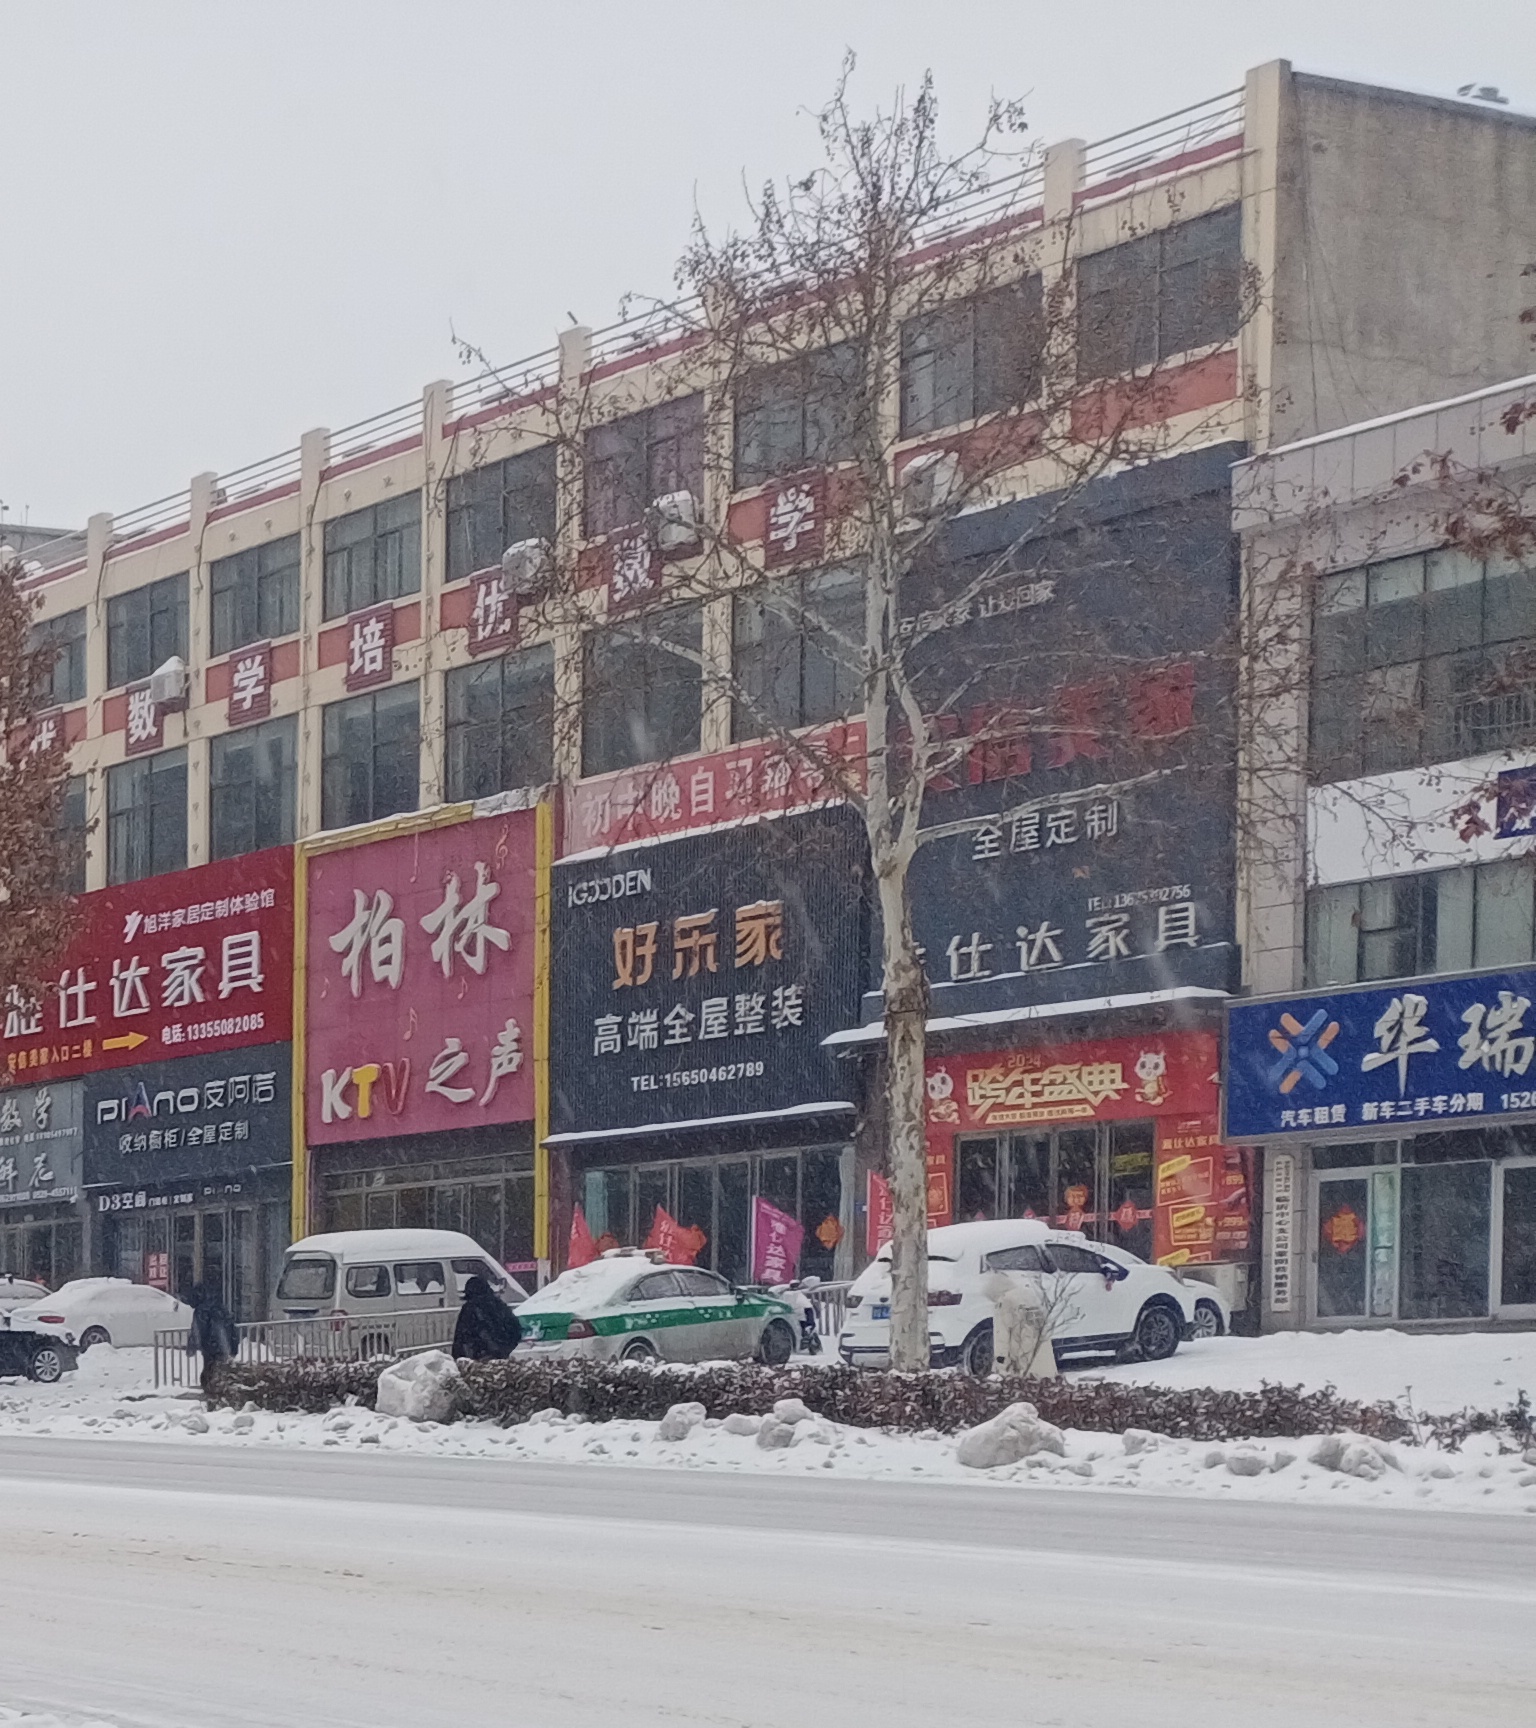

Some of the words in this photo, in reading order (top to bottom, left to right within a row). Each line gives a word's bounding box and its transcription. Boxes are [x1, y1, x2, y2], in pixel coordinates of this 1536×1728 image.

[972, 799, 1119, 861] 全屋定制
[329, 862, 514, 999] 柏林
[612, 899, 785, 991] 好乐家
[915, 901, 1201, 982] 仕达家具
[593, 983, 805, 1057] 高端全屋整装
[1360, 990, 1536, 1099] 华瑞
[320, 1057, 411, 1124] KTV
[424, 1017, 524, 1107] 之声
[630, 1060, 765, 1093] TEL:15650462789
[965, 1061, 1130, 1122] 跨年盛典
[1280, 1103, 1347, 1128] 汽车租赁
[1361, 1092, 1485, 1122] 新车二手车分期
